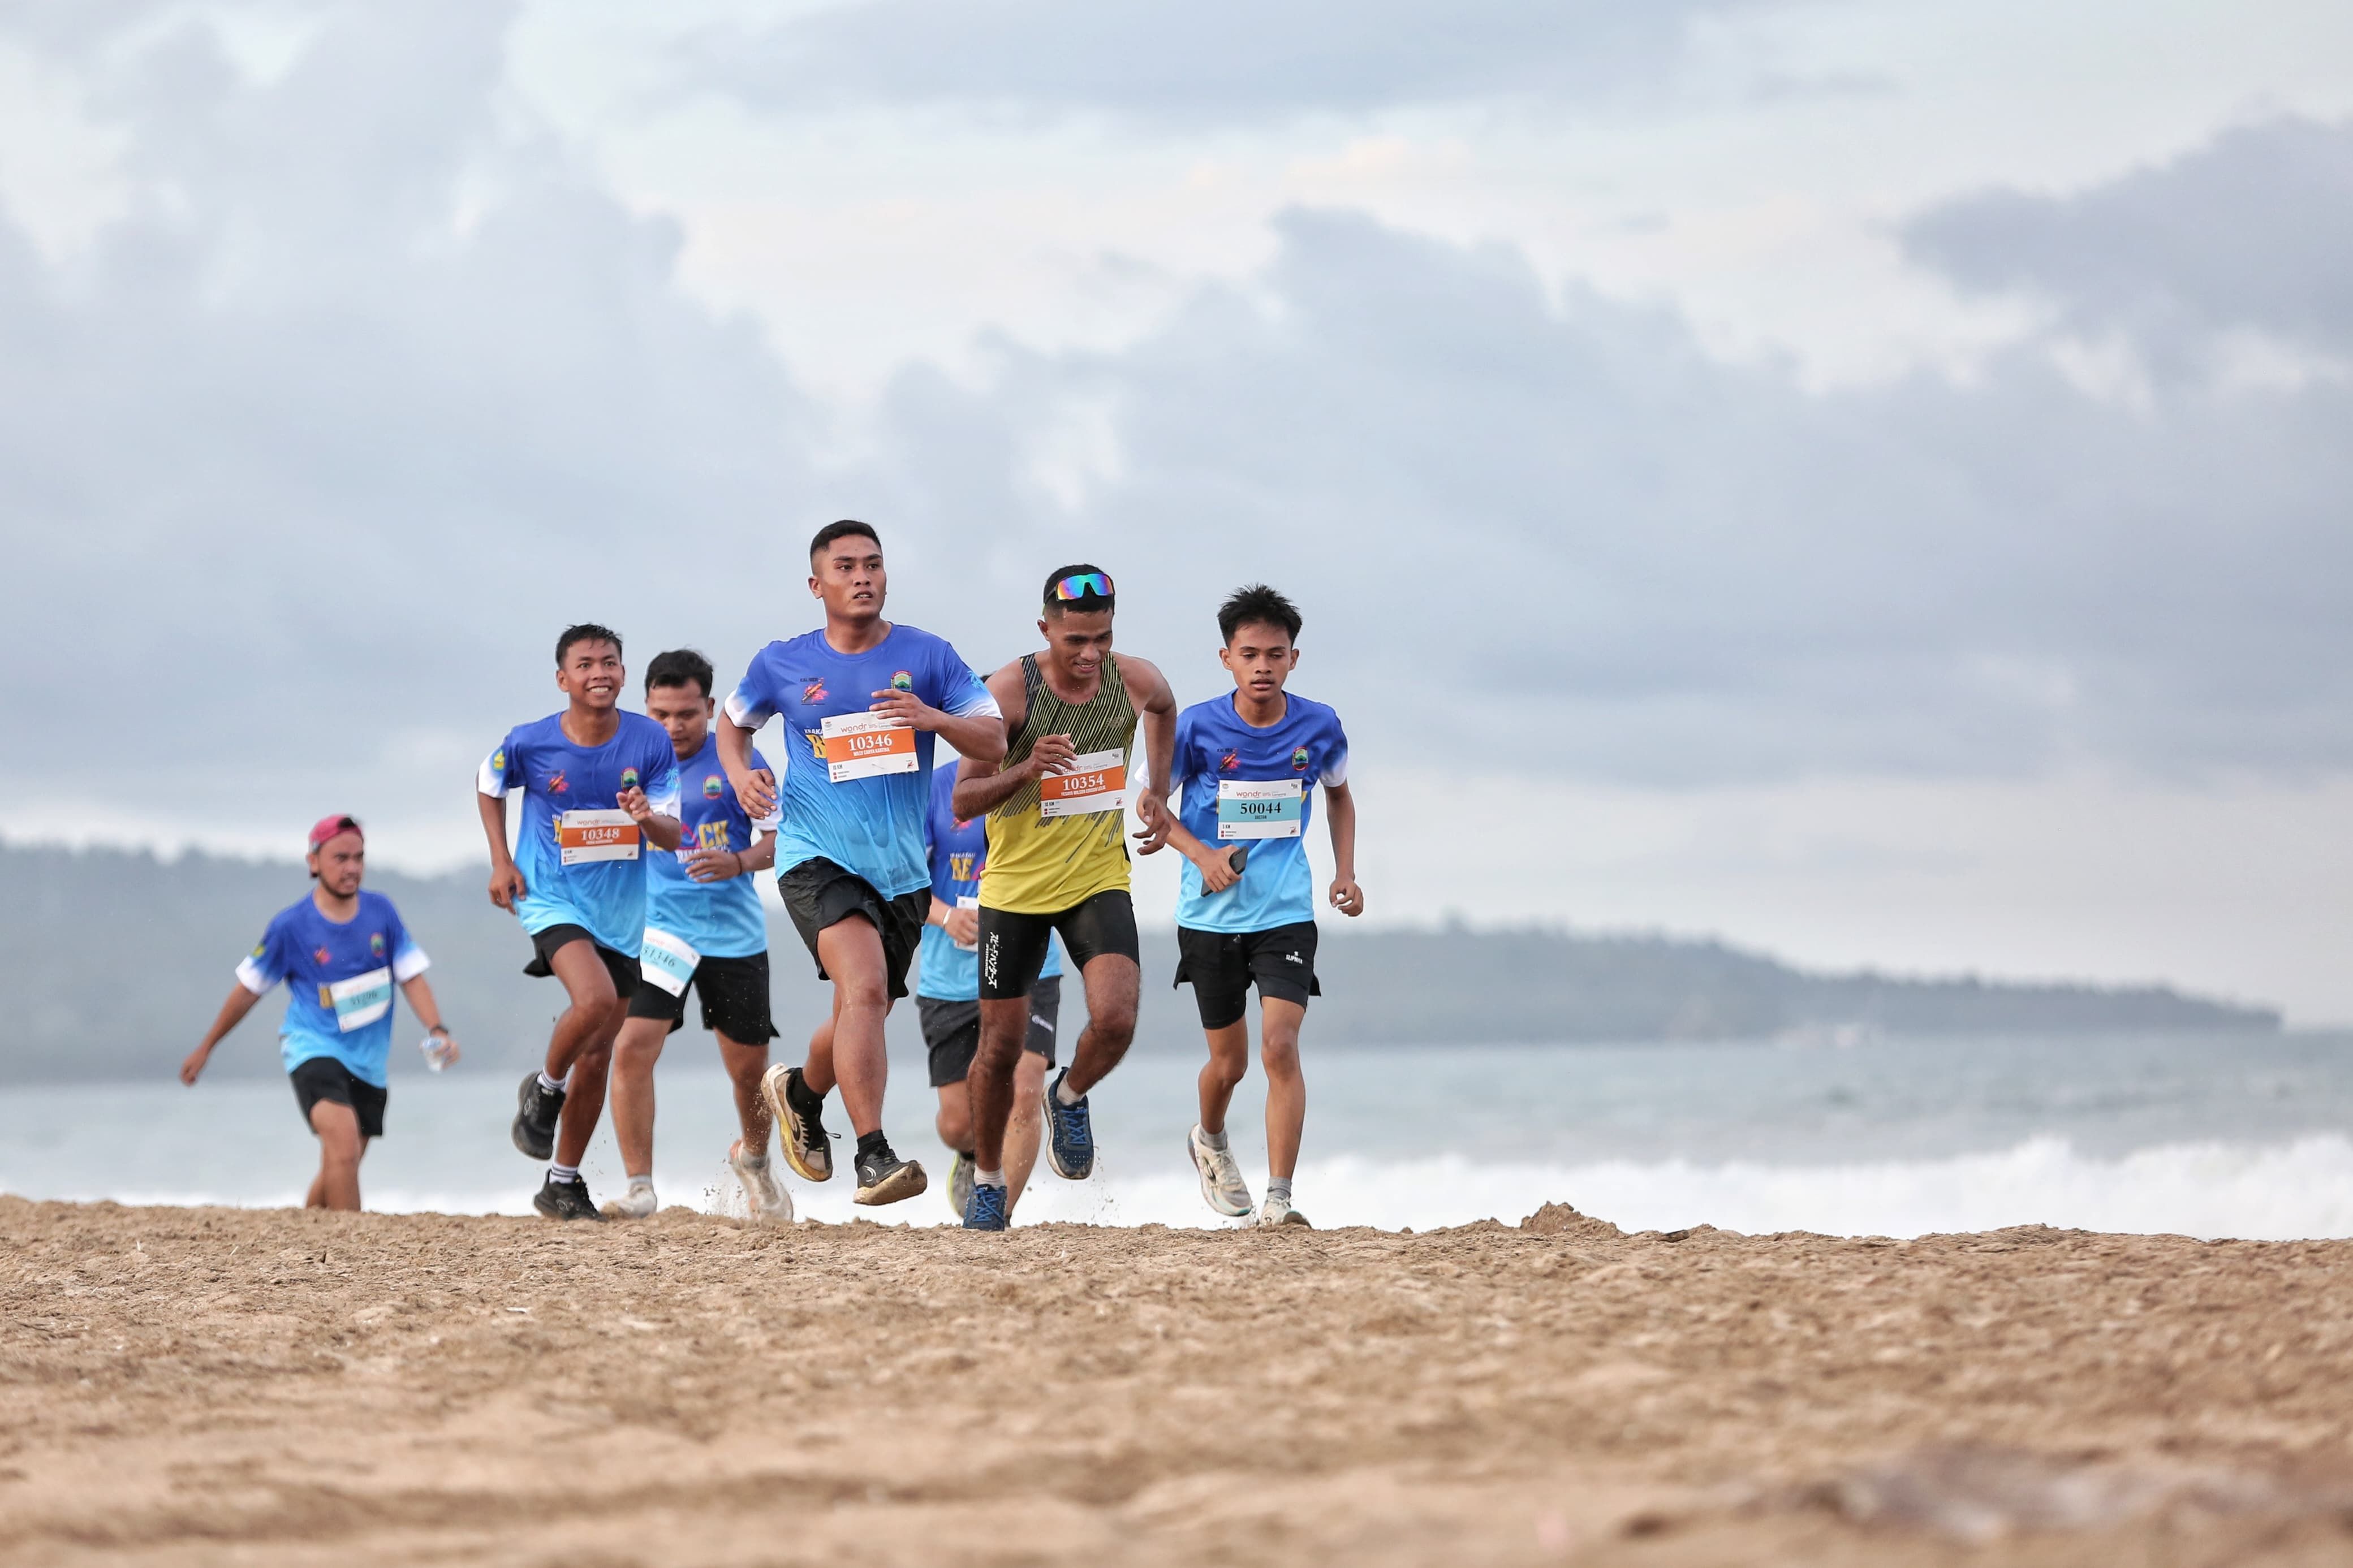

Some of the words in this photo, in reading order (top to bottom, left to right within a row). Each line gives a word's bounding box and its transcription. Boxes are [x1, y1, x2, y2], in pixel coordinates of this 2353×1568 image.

[841, 723, 867, 733] wondr
[848, 733, 893, 751] 10346
[1063, 773, 1104, 791] 10354
[1240, 802, 1281, 815] 50044
[581, 828, 620, 841] 10348
